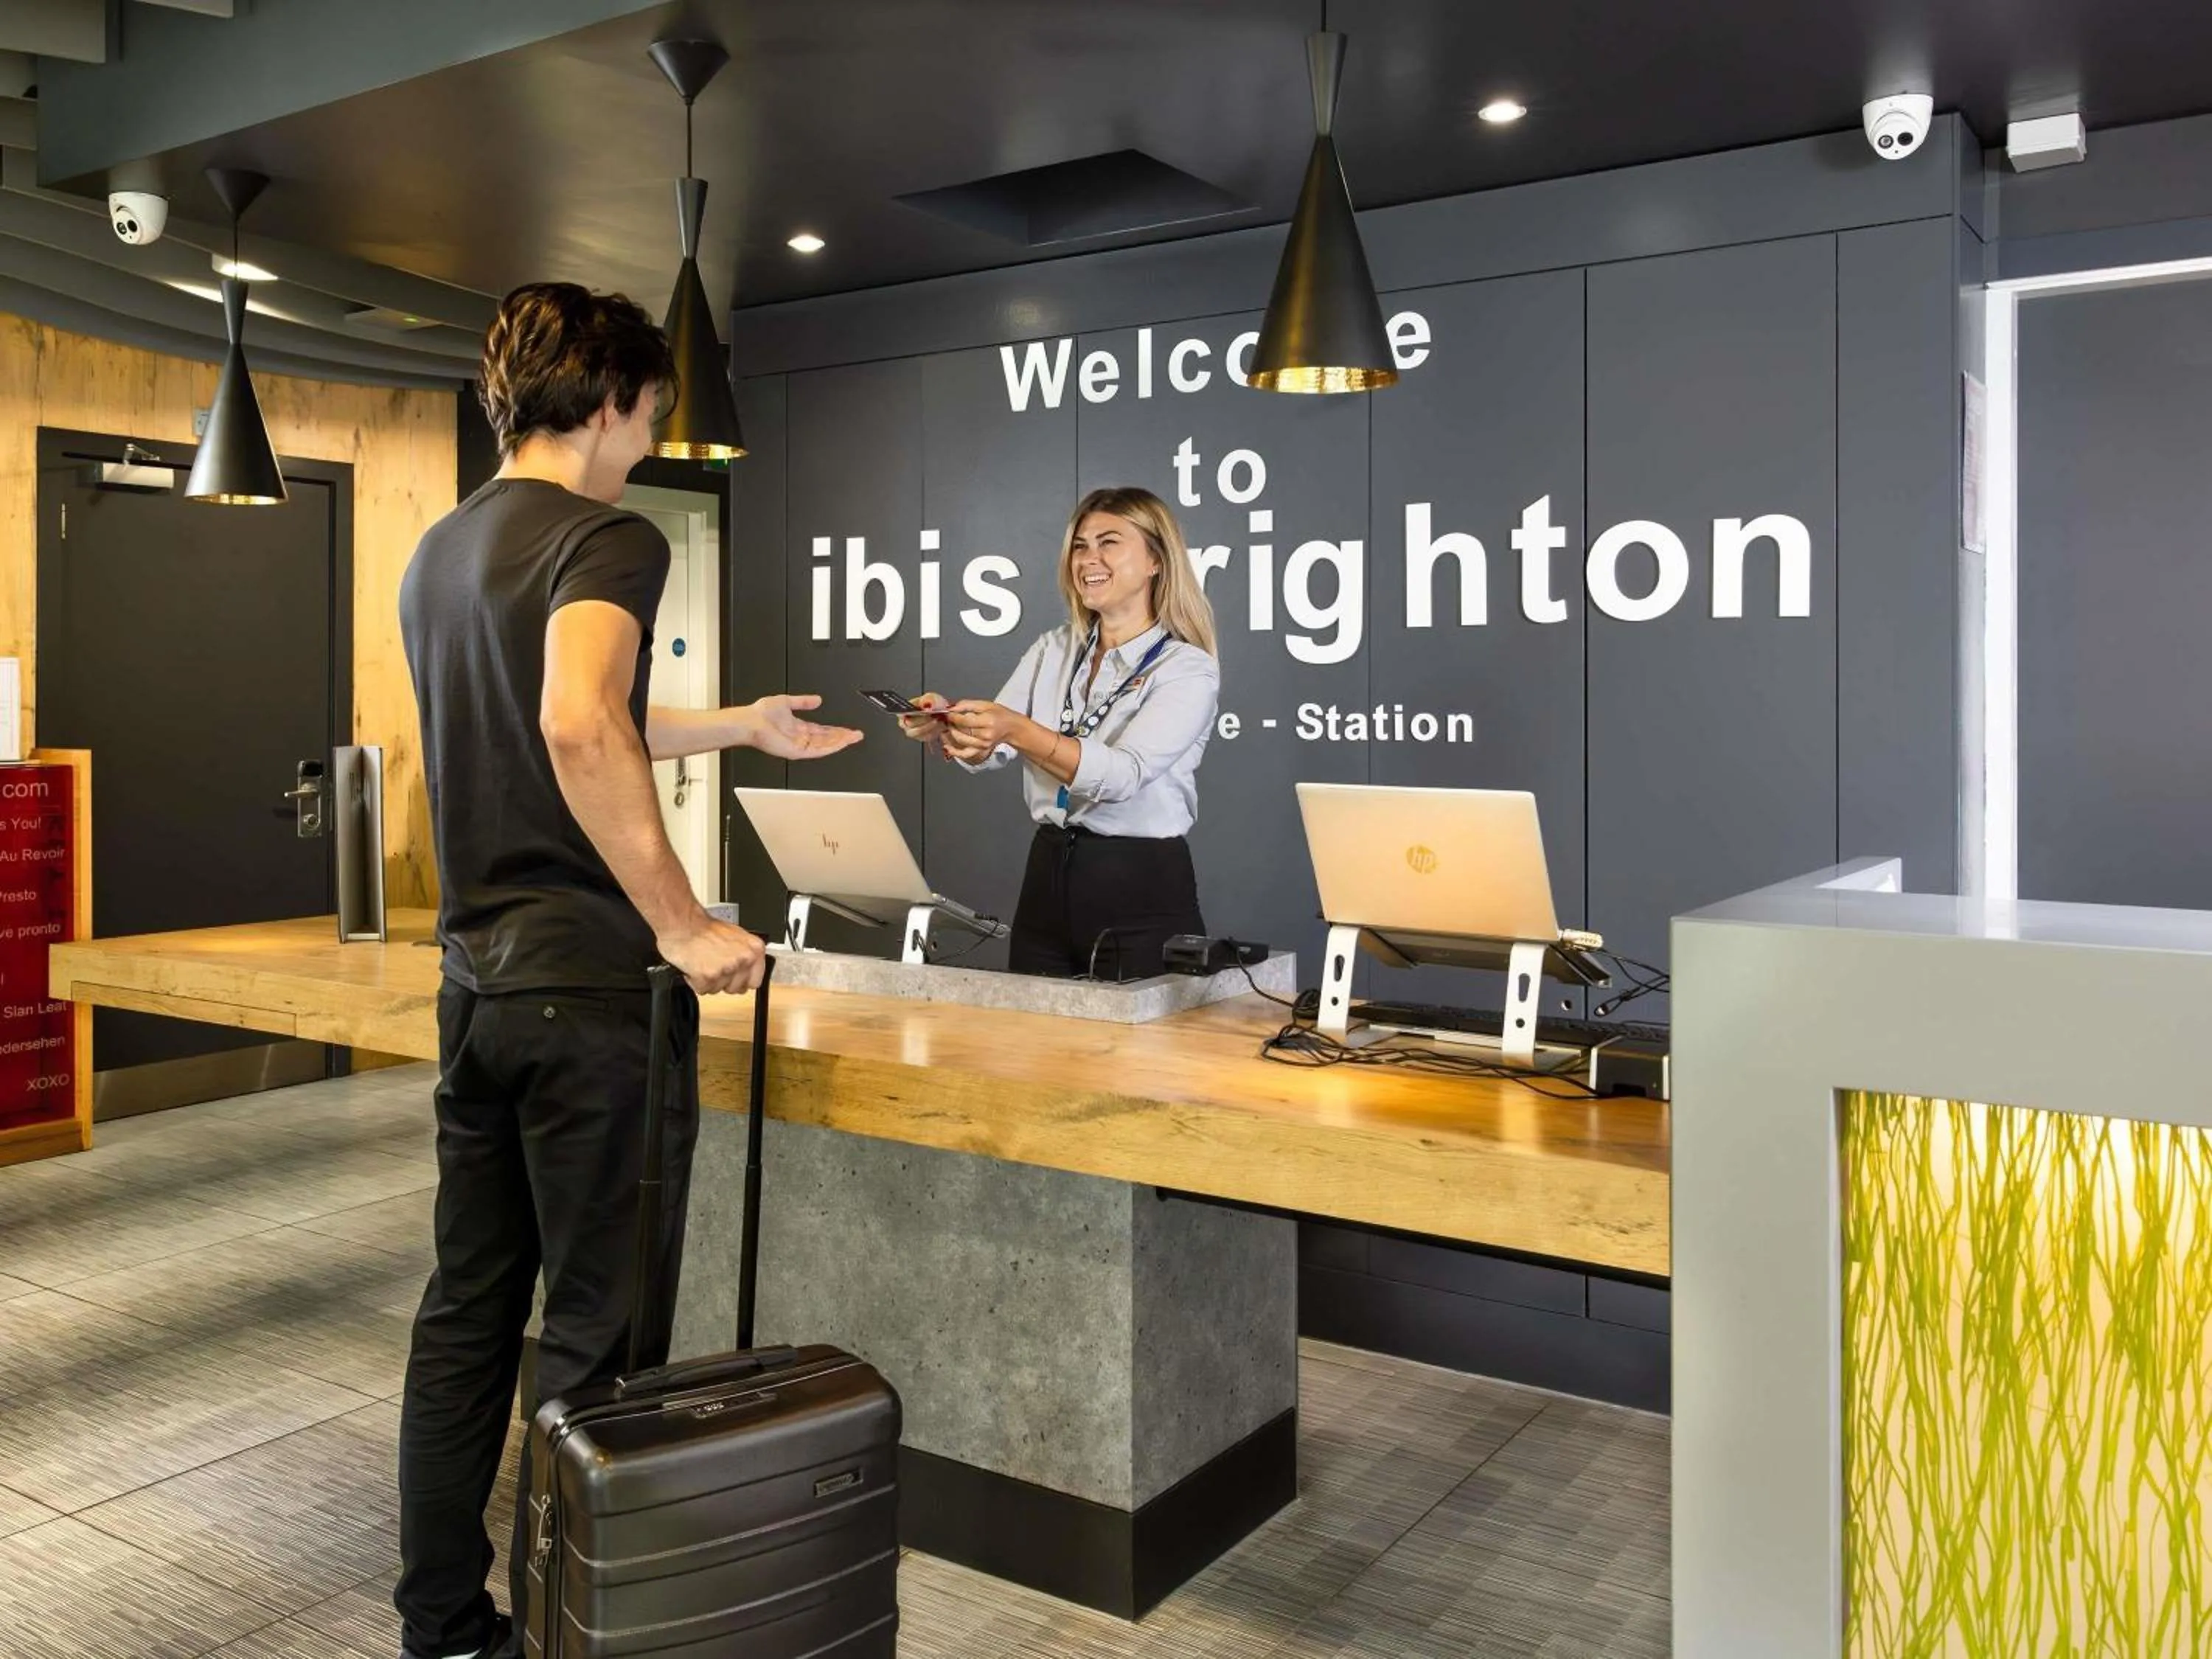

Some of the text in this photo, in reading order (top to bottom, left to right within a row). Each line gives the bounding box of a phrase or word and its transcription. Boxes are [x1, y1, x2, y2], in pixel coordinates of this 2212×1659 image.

[998, 310, 1432, 412] Welcoe
[1173, 436, 1267, 507] to
[812, 494, 1812, 665] ibis righton
[1295, 702, 1473, 743] Station
[22, 846, 65, 861] Revoir
[0, 889, 36, 902] resto
[0, 1035, 66, 1054] dersehen
